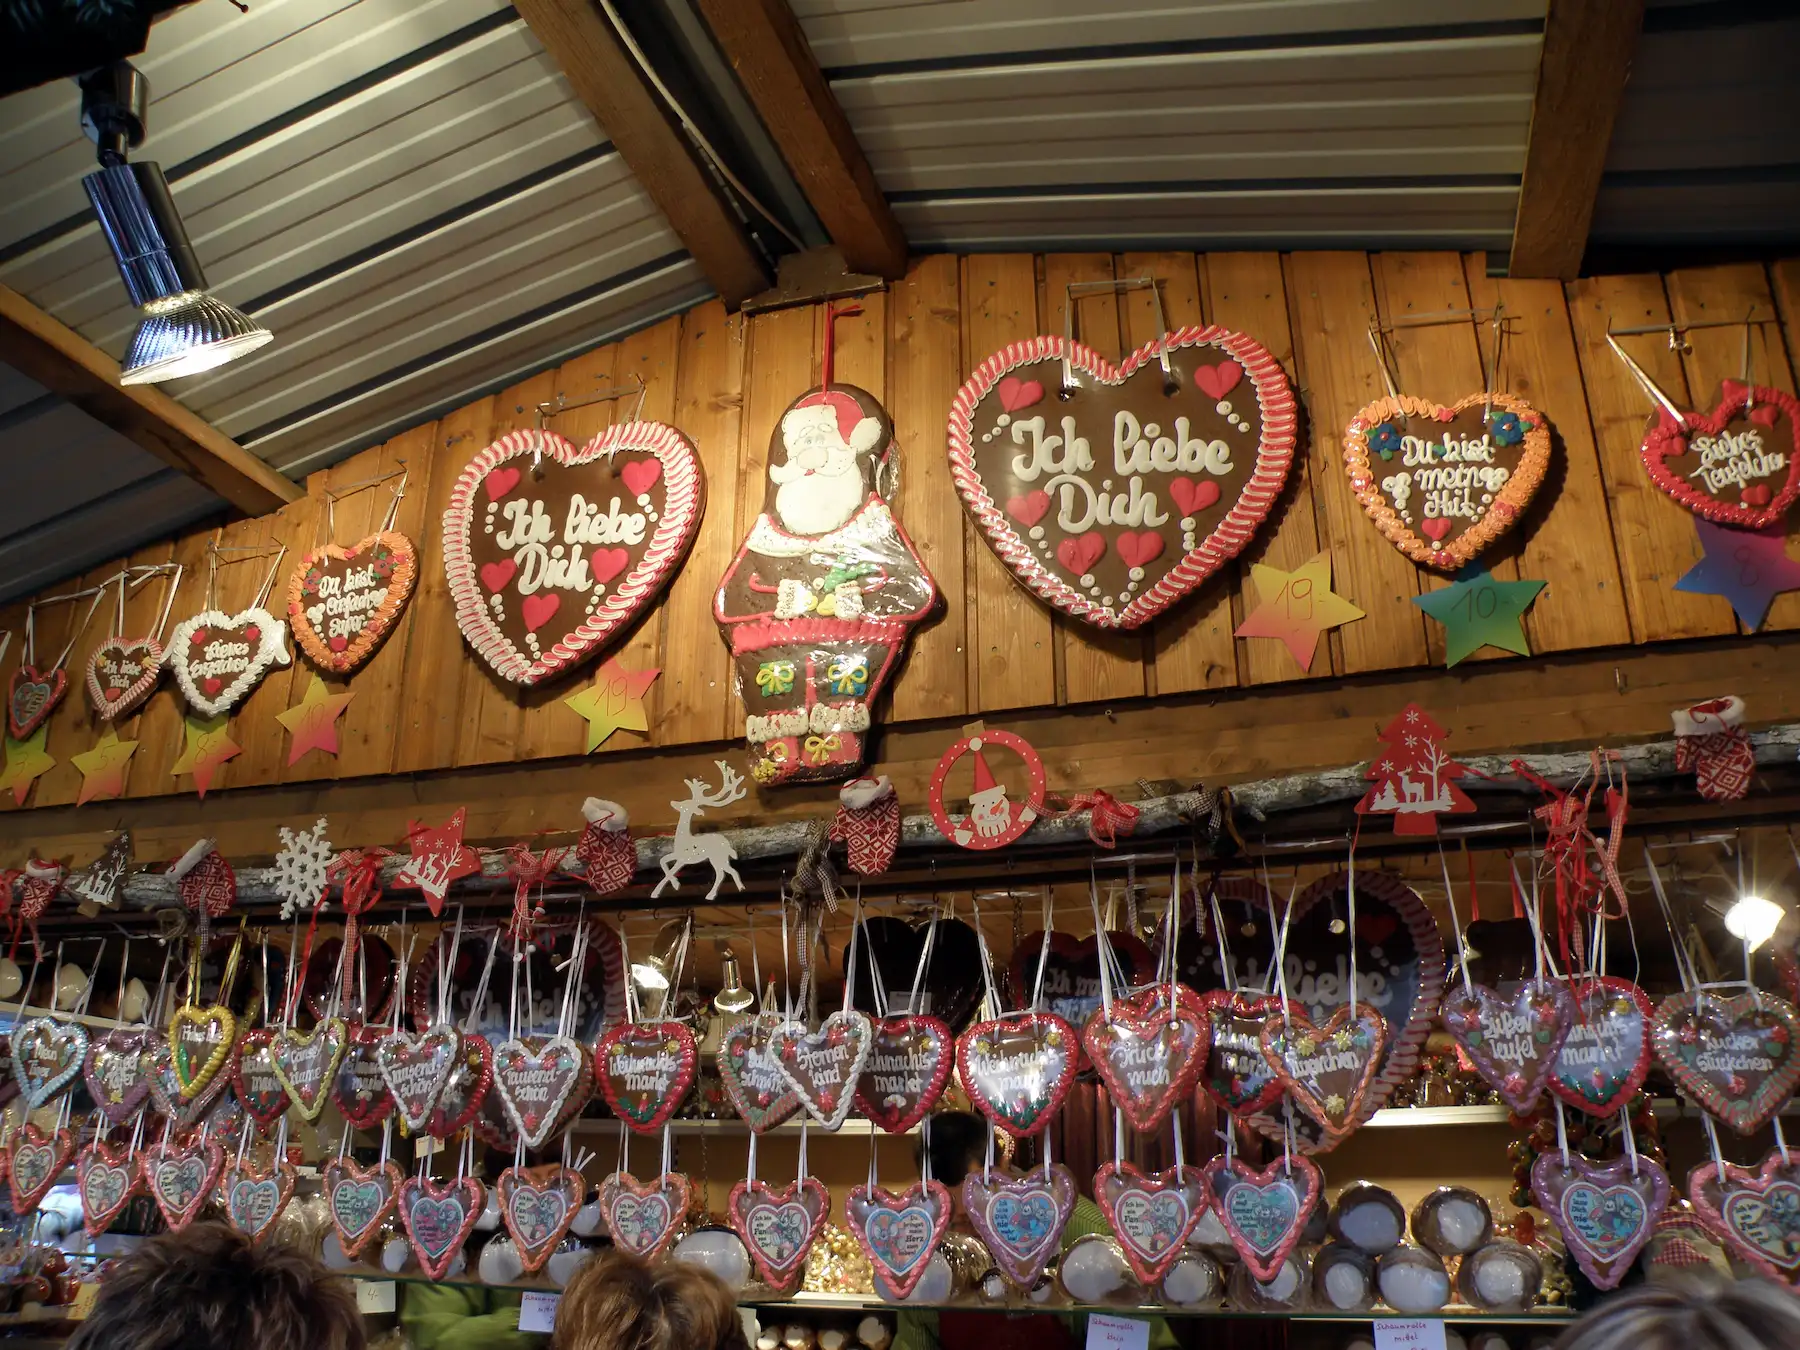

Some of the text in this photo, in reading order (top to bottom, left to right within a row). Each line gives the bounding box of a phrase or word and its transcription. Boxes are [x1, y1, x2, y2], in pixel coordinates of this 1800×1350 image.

[1010, 410, 1234, 482] Ich liebe
[1400, 432, 1496, 467] Du bist
[1690, 429, 1764, 466] Liebes
[1414, 463, 1483, 491] mein
[496, 494, 647, 550] Ich liebe
[1043, 474, 1169, 535] Dich
[318, 564, 376, 599] Du bist
[515, 543, 594, 595] Dich
[204, 639, 249, 661] Liebes
[103, 660, 142, 676] Ich liebe
[109, 675, 130, 688] Dich
[906, 1235, 924, 1243] Herz
[1376, 1321, 1427, 1331] Schaumrolle
